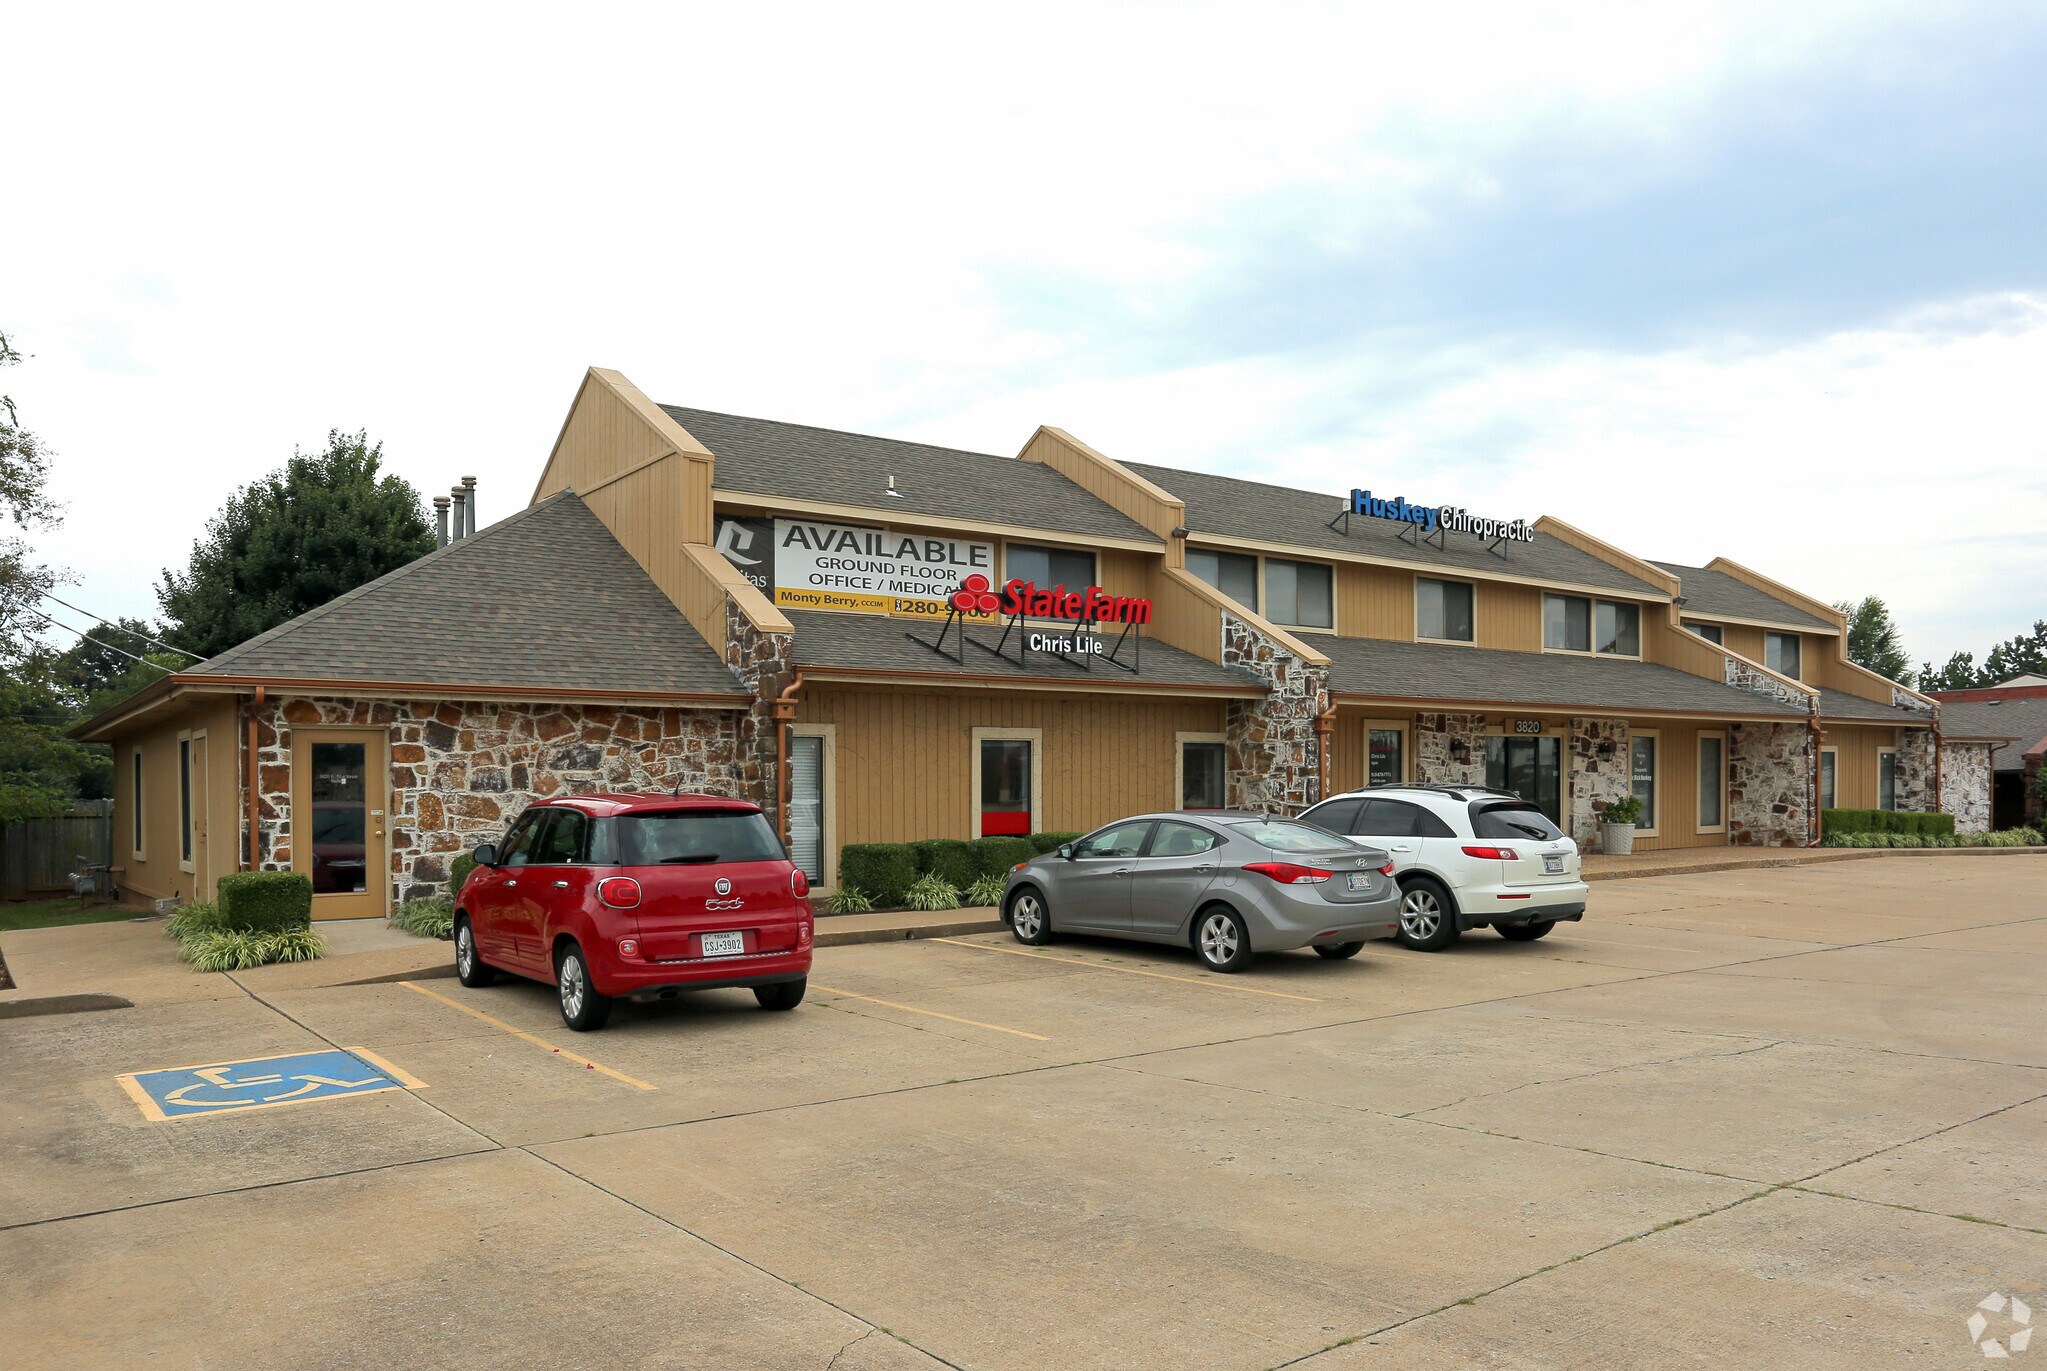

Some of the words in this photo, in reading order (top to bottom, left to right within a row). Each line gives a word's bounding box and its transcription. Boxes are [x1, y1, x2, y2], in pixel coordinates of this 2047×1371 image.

[1352, 489, 1438, 532] Huskey
[1440, 505, 1534, 542] Chiropractic
[782, 525, 988, 568] AVAILABLE
[815, 556, 895, 575] GROUND
[901, 565, 957, 581] FLOOR
[808, 573, 872, 590] OFFICE
[877, 579, 884, 591] /
[889, 580, 959, 596] MEDICA
[781, 591, 821, 605] Monty
[824, 594, 859, 608] Berry,
[1030, 634, 1071, 653] Chris
[1076, 636, 1103, 654] Lile
[1516, 721, 1540, 733] 3820
